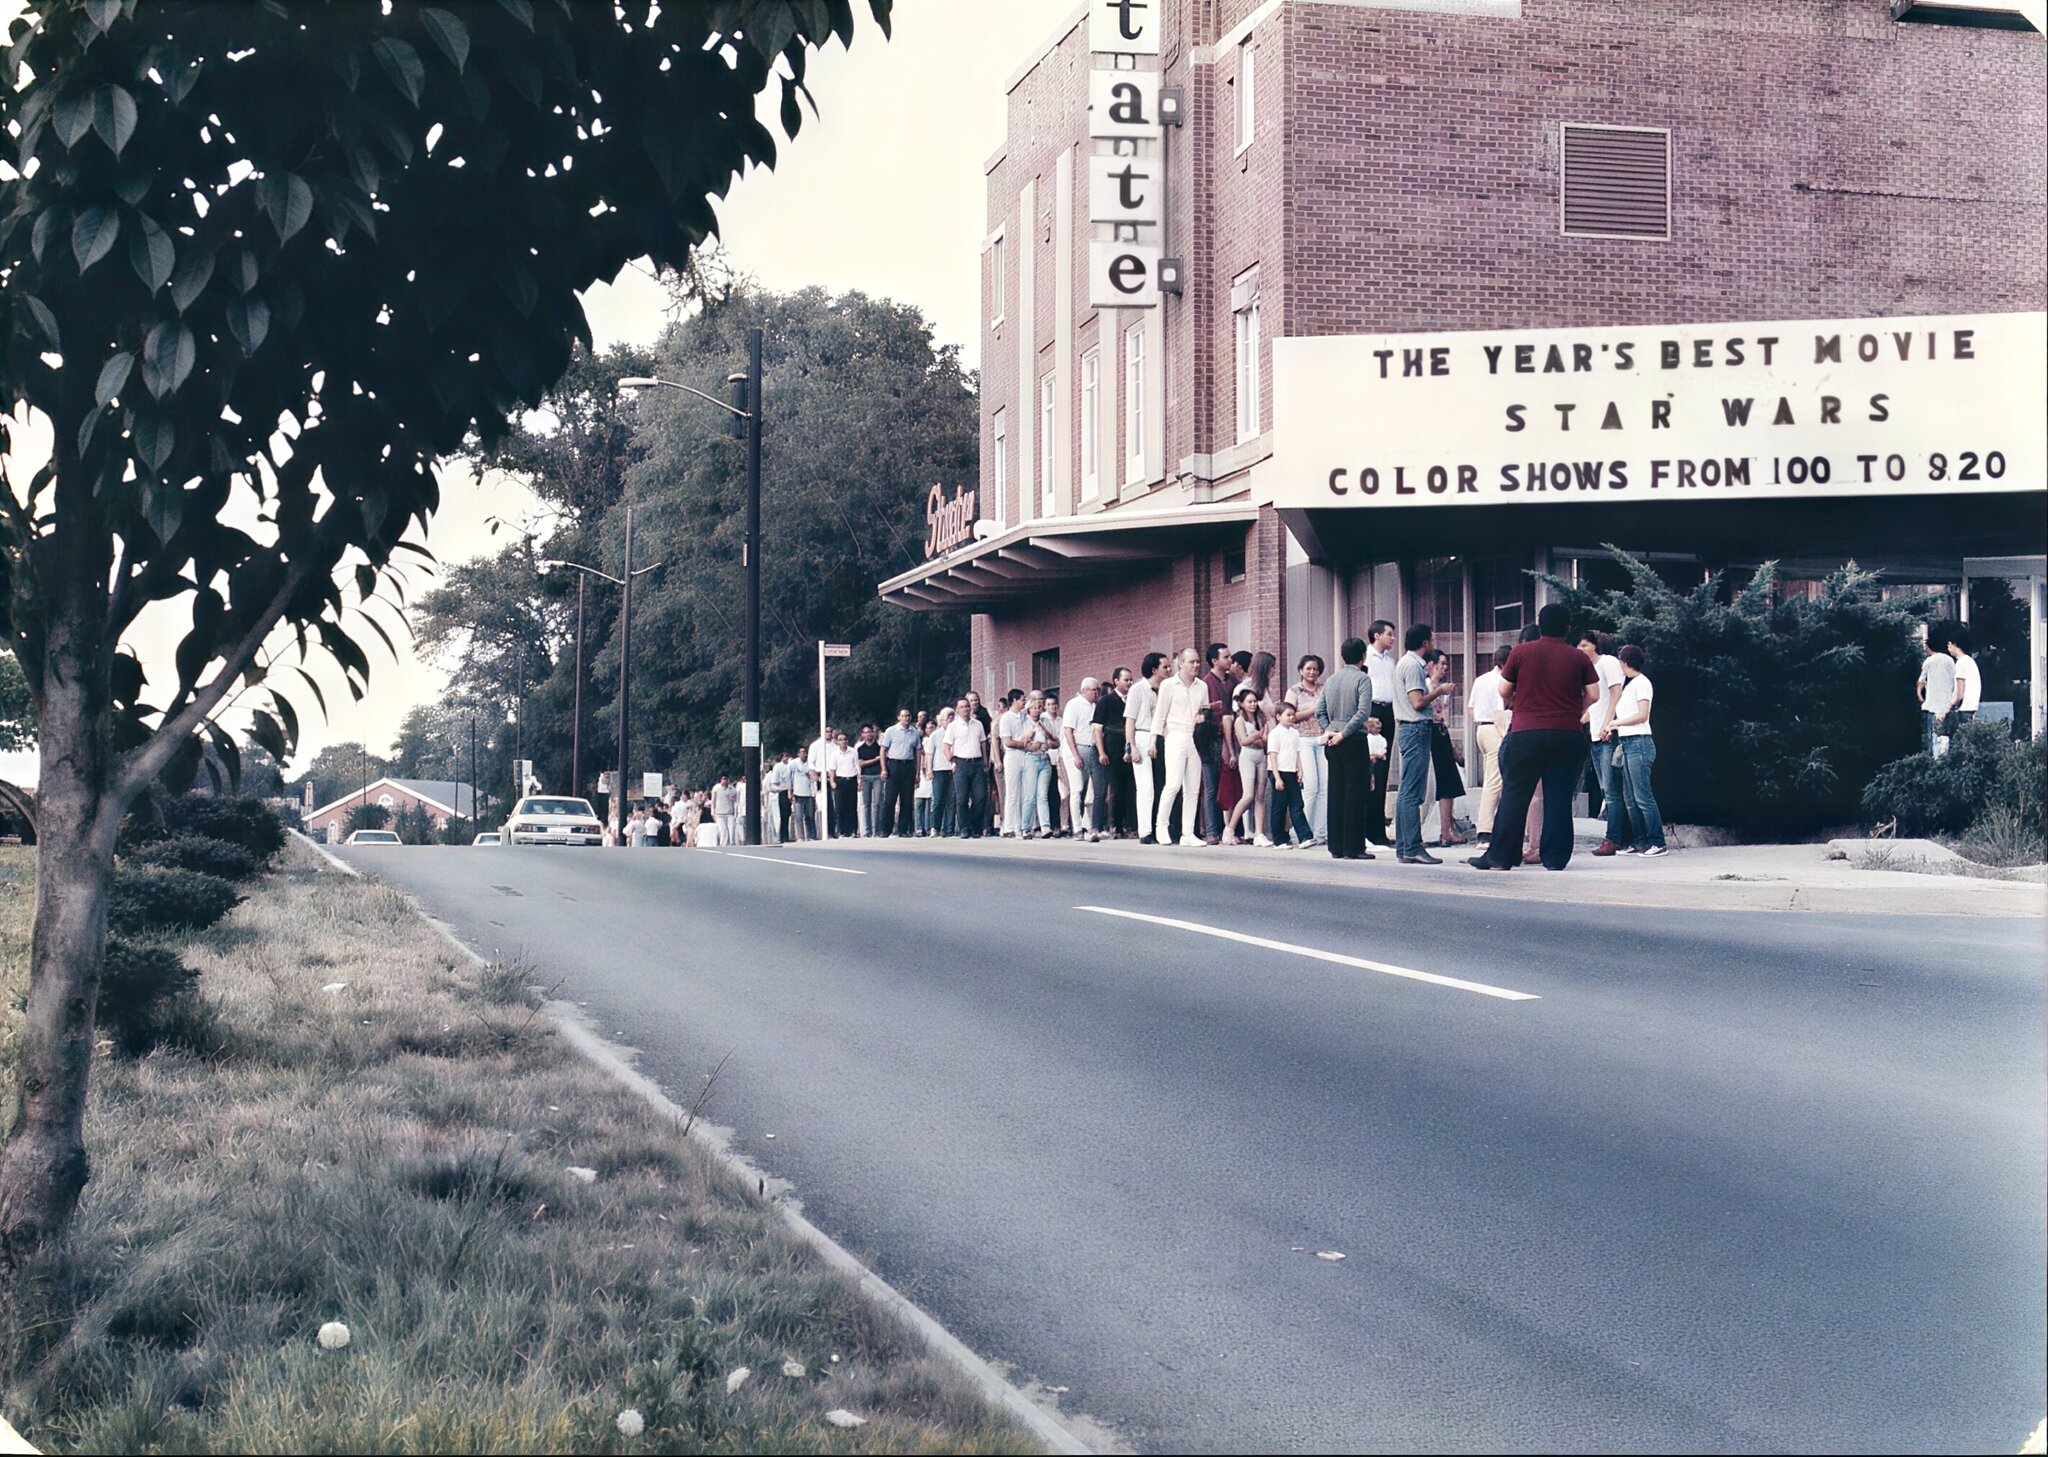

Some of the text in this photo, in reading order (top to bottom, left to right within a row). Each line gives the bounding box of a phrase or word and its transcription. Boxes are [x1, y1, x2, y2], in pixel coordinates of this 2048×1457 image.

[1373, 329, 1976, 379] THE YEAR'S BEST MOVIE
[1505, 393, 1890, 433] STAR WARS
[1328, 464, 1479, 496] COLOR
[1499, 460, 1628, 492] SHOWS
[1650, 457, 1751, 489] FROM
[1773, 455, 1831, 485] 100
[1856, 453, 1906, 483] TO
